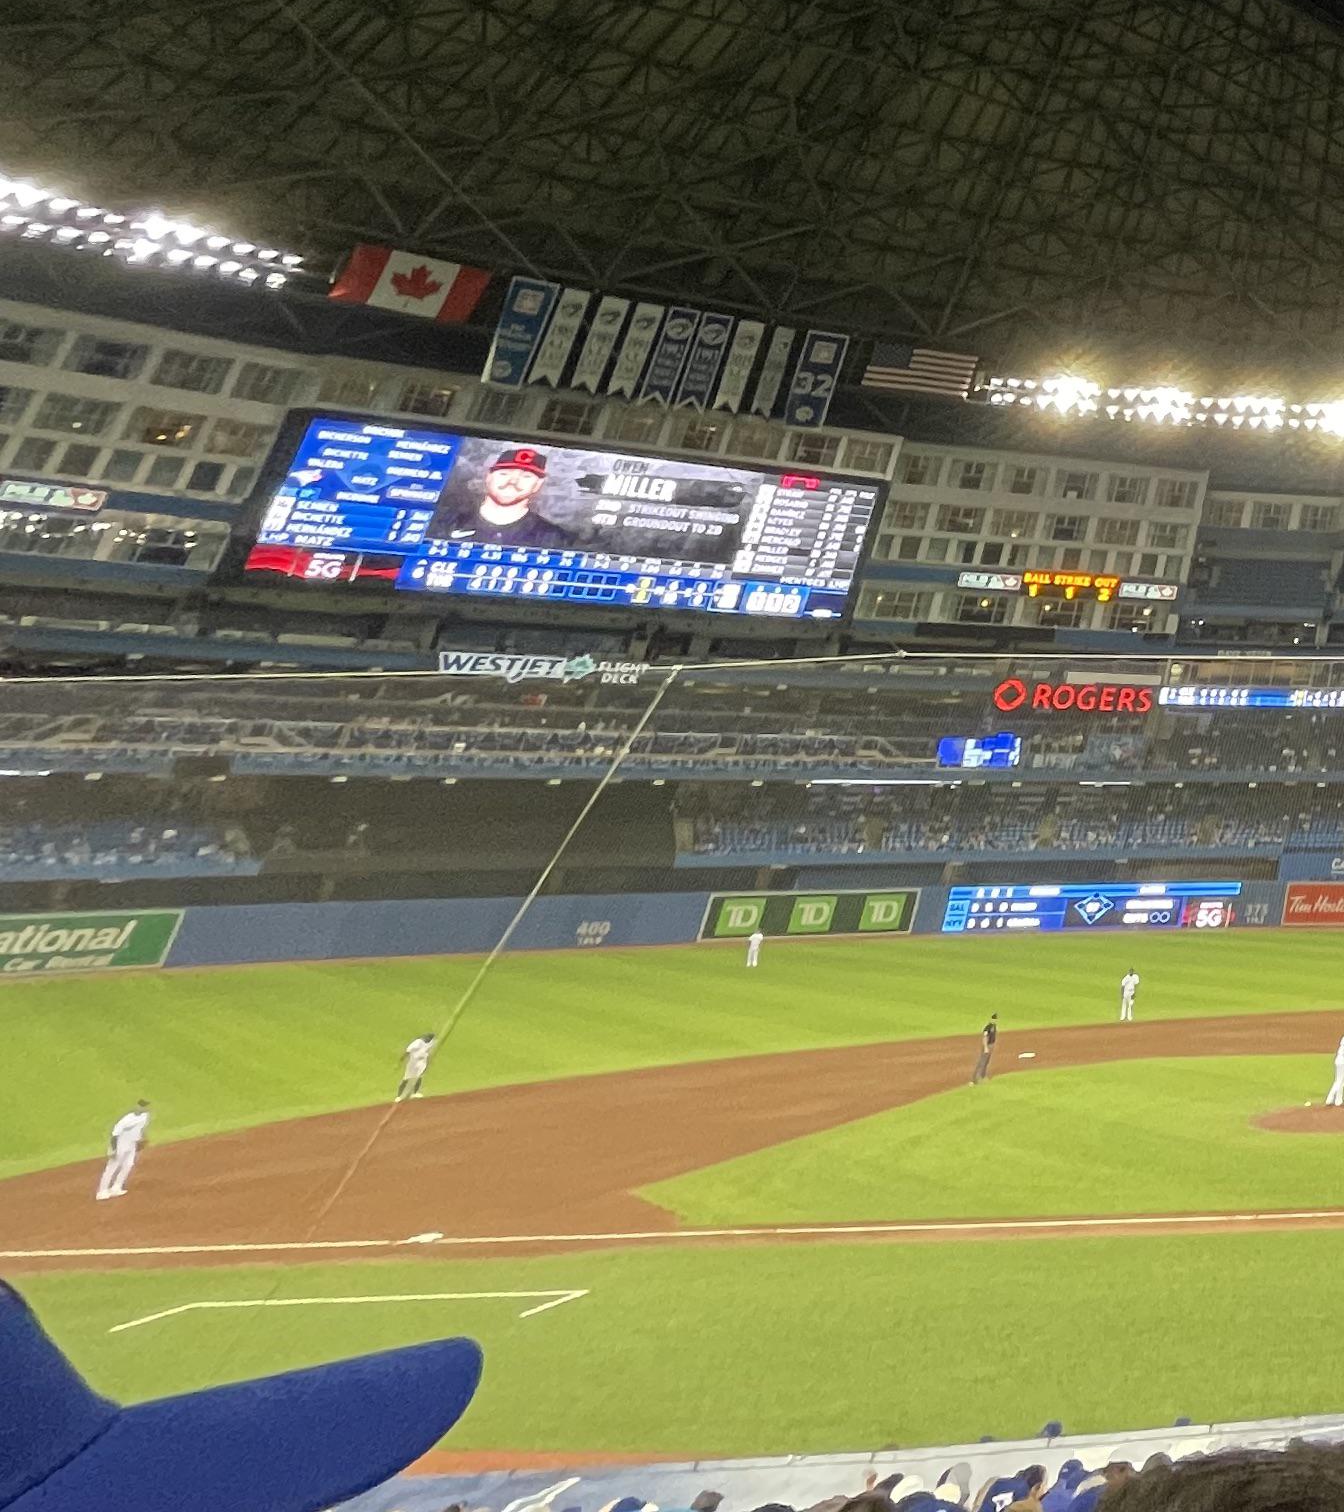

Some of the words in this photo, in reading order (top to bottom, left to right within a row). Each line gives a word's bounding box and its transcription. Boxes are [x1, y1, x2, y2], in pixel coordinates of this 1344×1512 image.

[796, 371, 834, 397] 32
[613, 458, 650, 475] OWEN
[601, 473, 678, 502] MILLER
[304, 559, 342, 579] 5G
[1024, 572, 1051, 585] BALL
[1054, 574, 1092, 587] STRIKE
[1094, 576, 1118, 588] OUT
[1097, 588, 1112, 602] 2
[441, 653, 564, 680] WESTJET
[600, 661, 650, 673] FLIGHT
[600, 674, 639, 685] DECK
[1032, 683, 1153, 713] ROGERS
[798, 901, 829, 925] TD
[869, 899, 899, 923] TD
[1289, 896, 1312, 913] Tim
[726, 903, 758, 927] TD
[1196, 910, 1222, 927] 5G
[577, 920, 611, 936] 400
